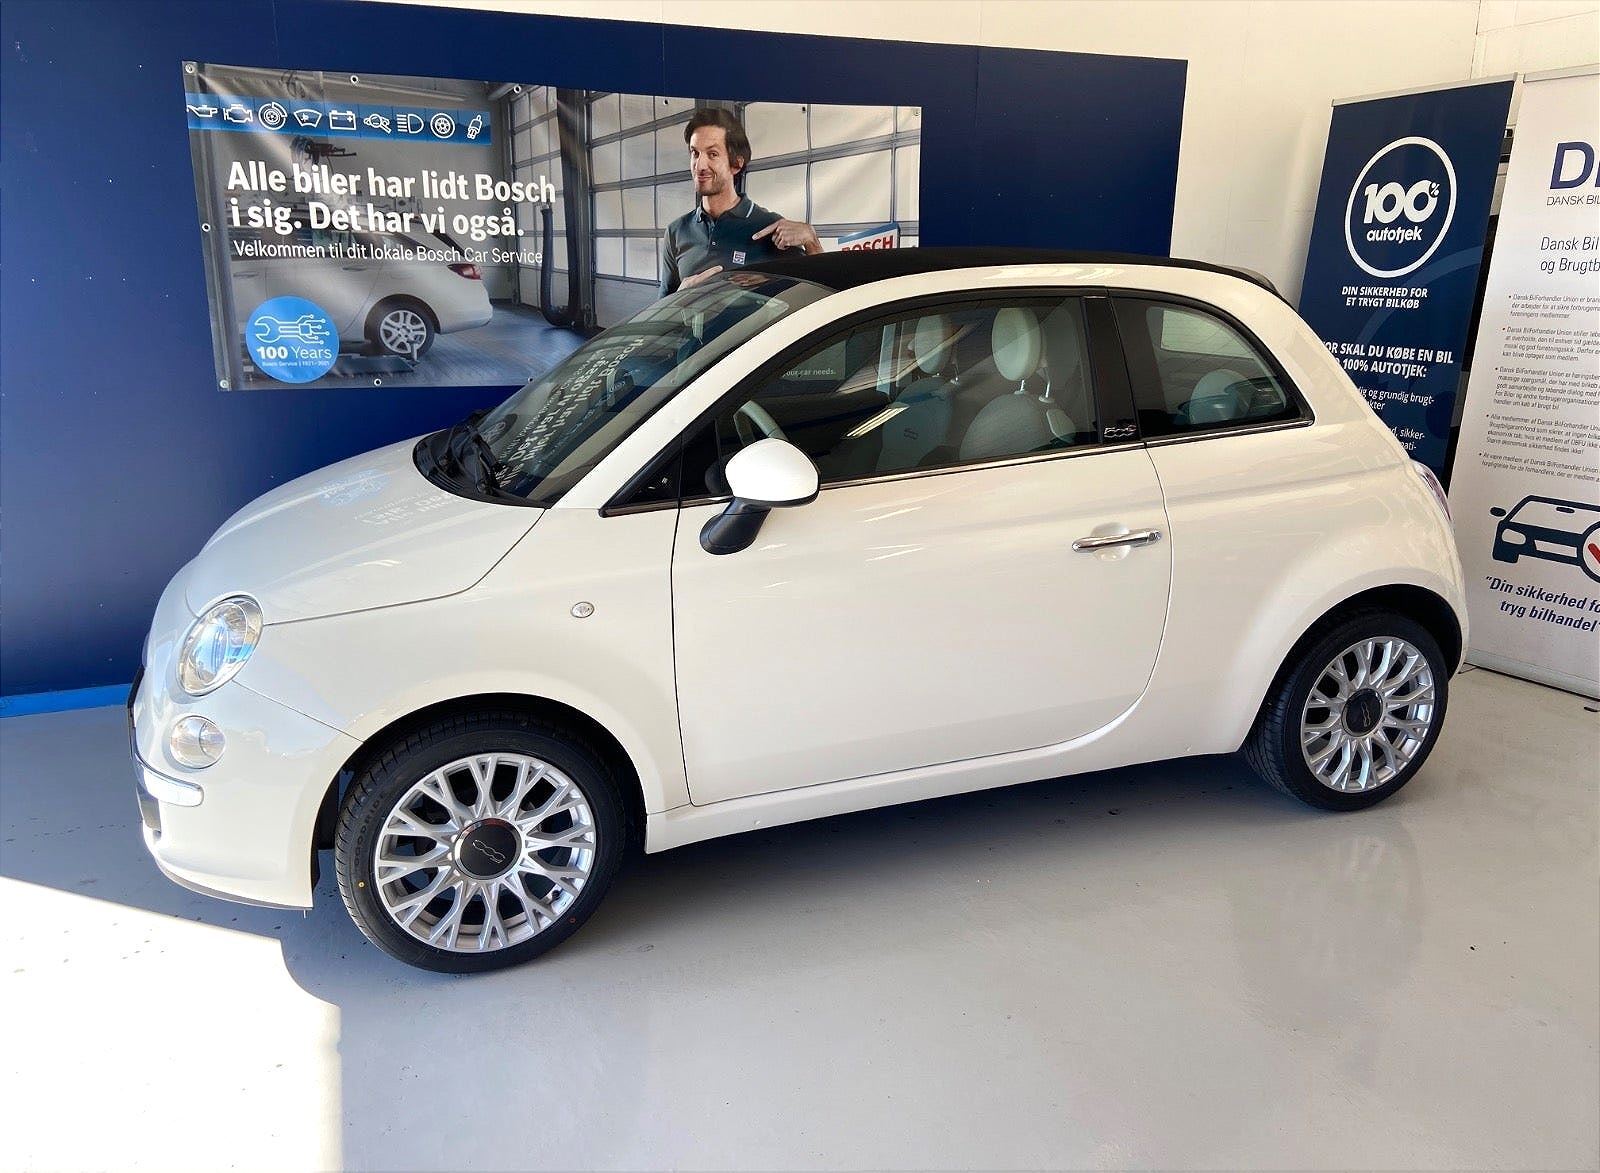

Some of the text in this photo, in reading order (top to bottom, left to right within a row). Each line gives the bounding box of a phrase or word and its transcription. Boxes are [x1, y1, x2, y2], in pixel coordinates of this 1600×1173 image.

[1550, 142, 1600, 189] D
[228, 161, 556, 202] Alle biler har lidt Bosch
[1364, 180, 1440, 224] 100%
[1546, 196, 1584, 206] DANSK
[230, 198, 524, 242] i sig. Det har vi også.
[1366, 226, 1422, 244] autotjek
[1541, 236, 1600, 250] Dansk Bil
[233, 240, 543, 264] Velkommen til dit lokale Bosch Car Service
[1541, 260, 1555, 274] og
[1342, 286, 1428, 298] DIN SIKKERHED FOR
[1346, 298, 1420, 308] ET TRYGT BILKØB
[256, 346, 332, 360] 100 Years
[1340, 343, 1366, 356] SKAL
[1368, 345, 1384, 357] DU
[1386, 347, 1416, 360] KØBE
[1418, 349, 1432, 362] EN
[1436, 350, 1454, 364] BIL
[1341, 358, 1368, 372] 100%
[1370, 361, 1427, 378] AUTOTJEK:
[1368, 388, 1378, 400] og
[1379, 390, 1408, 403] grundig
[1410, 392, 1434, 406] brugt-
[1400, 428, 1425, 440] sikker-
[1516, 585, 1587, 610] sikkerhed
[1500, 600, 1526, 618] tryg
